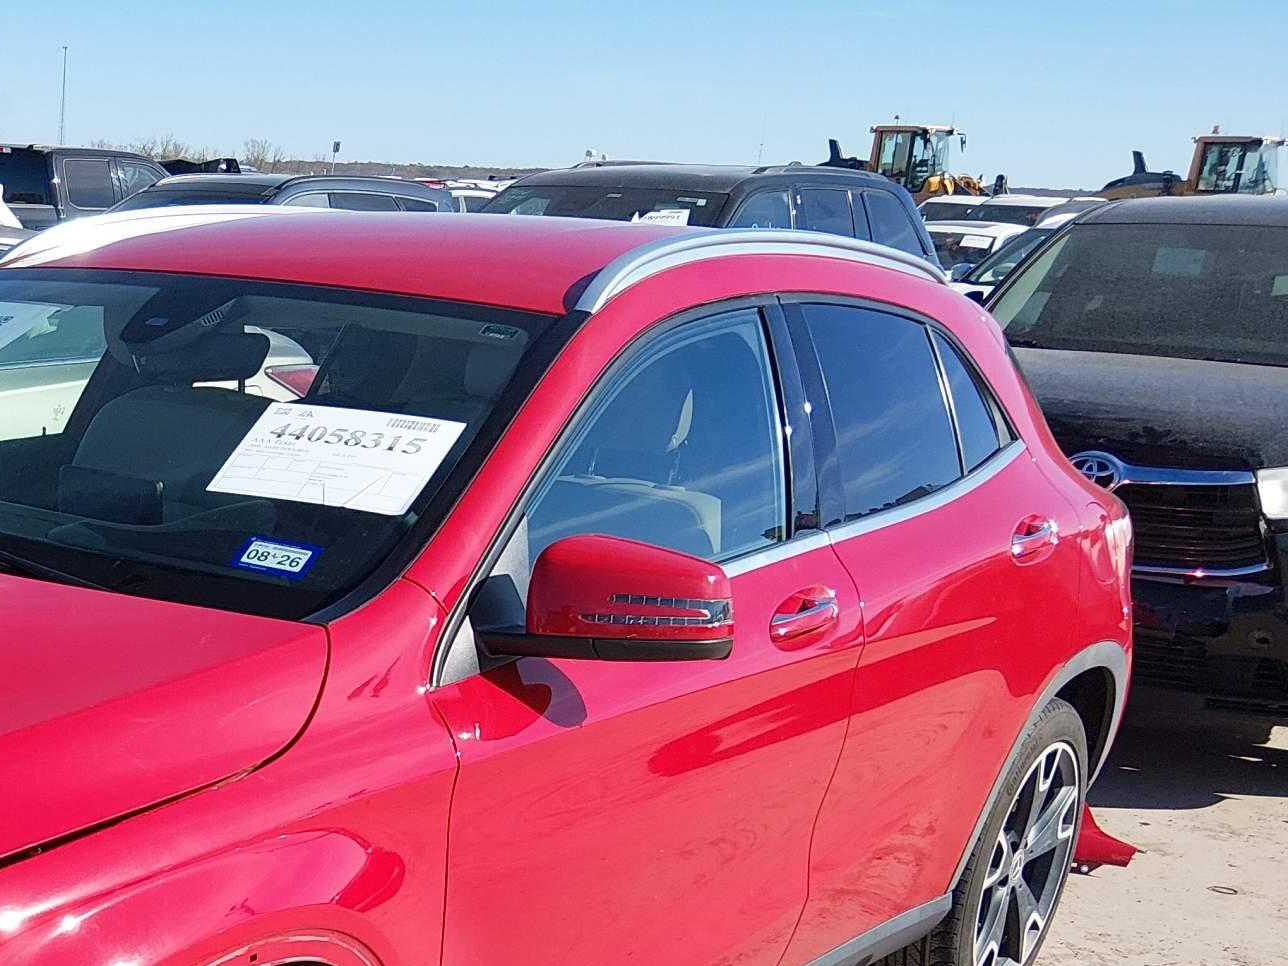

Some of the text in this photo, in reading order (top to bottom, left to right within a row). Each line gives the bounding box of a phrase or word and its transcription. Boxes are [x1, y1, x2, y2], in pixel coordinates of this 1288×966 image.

[270, 422, 428, 455] 44058315
[246, 548, 271, 562] 08
[276, 554, 303, 568] 26
